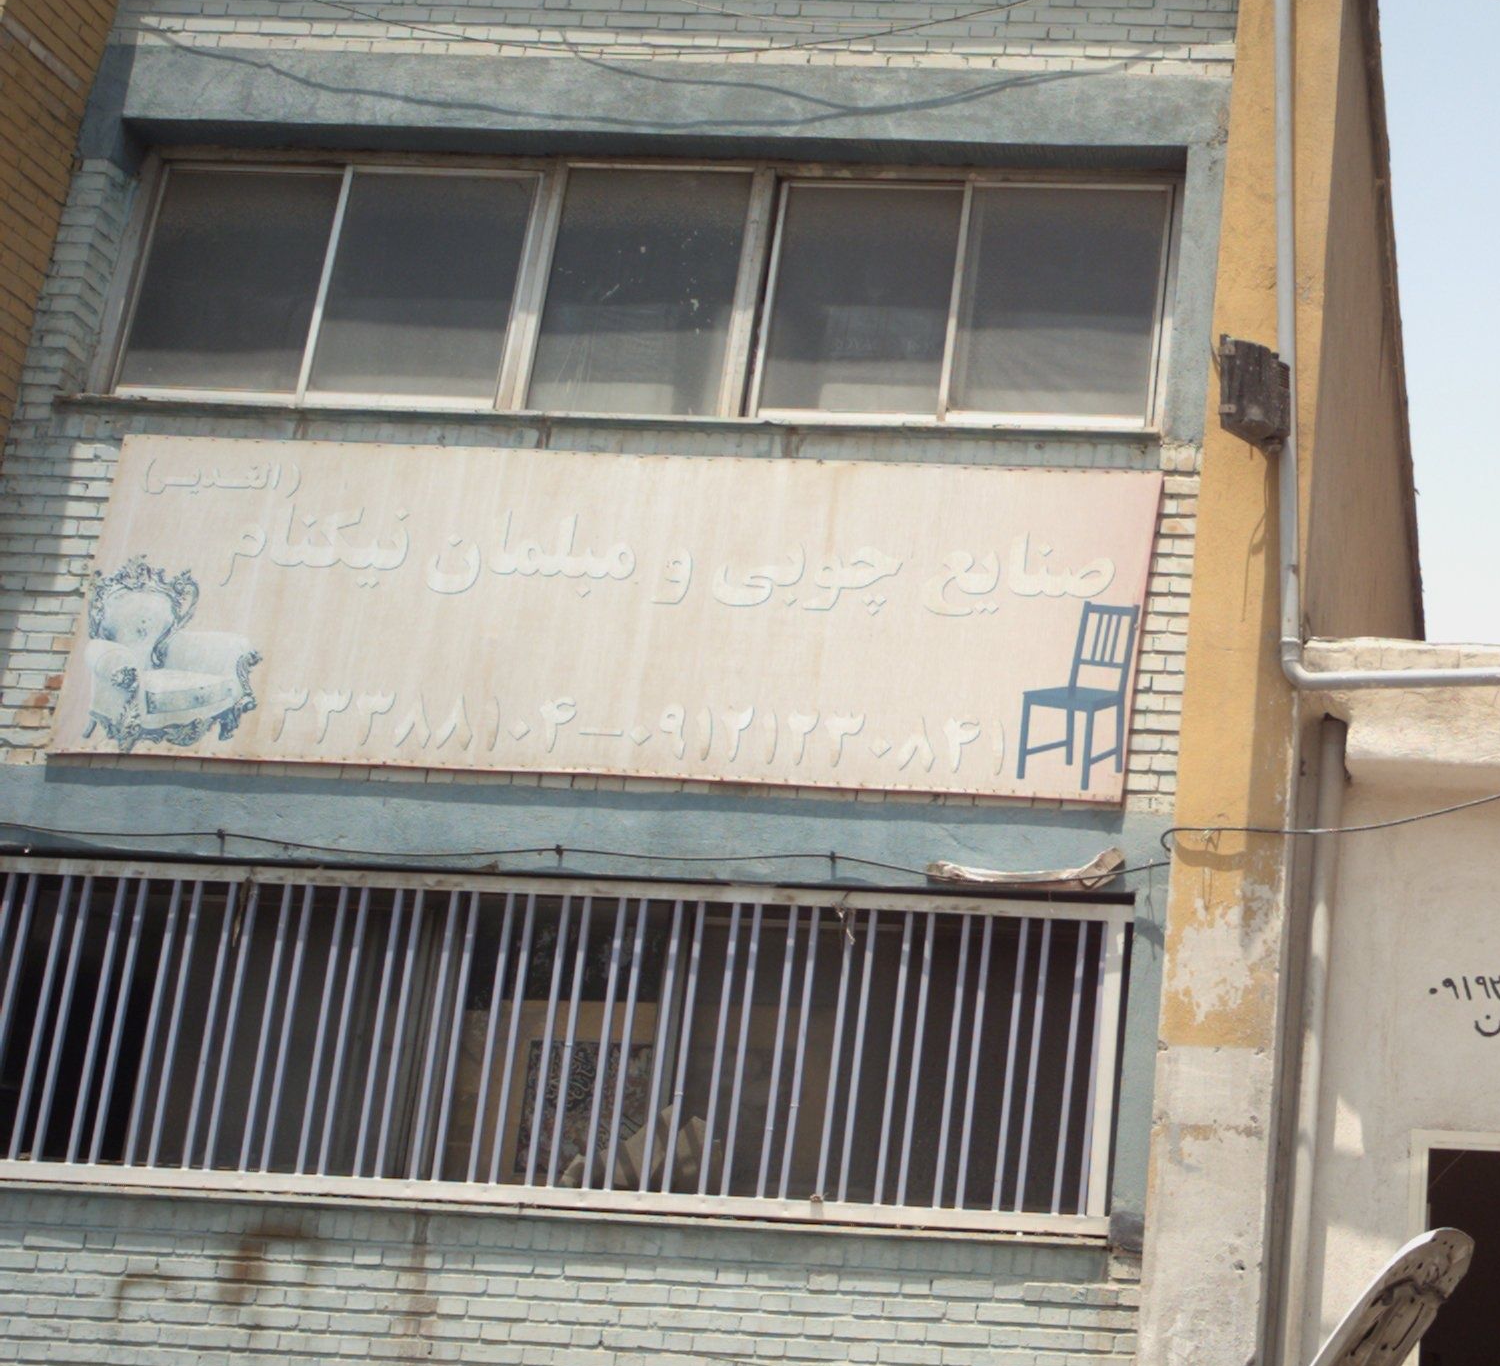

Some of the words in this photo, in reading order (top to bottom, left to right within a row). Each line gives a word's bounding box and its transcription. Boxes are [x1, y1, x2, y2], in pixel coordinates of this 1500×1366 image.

[219, 503, 411, 587] نیکنام
[424, 509, 638, 598] مبلمان
[651, 545, 693, 604] و
[712, 542, 905, 616] چوبی
[923, 531, 1117, 617] صنایع
